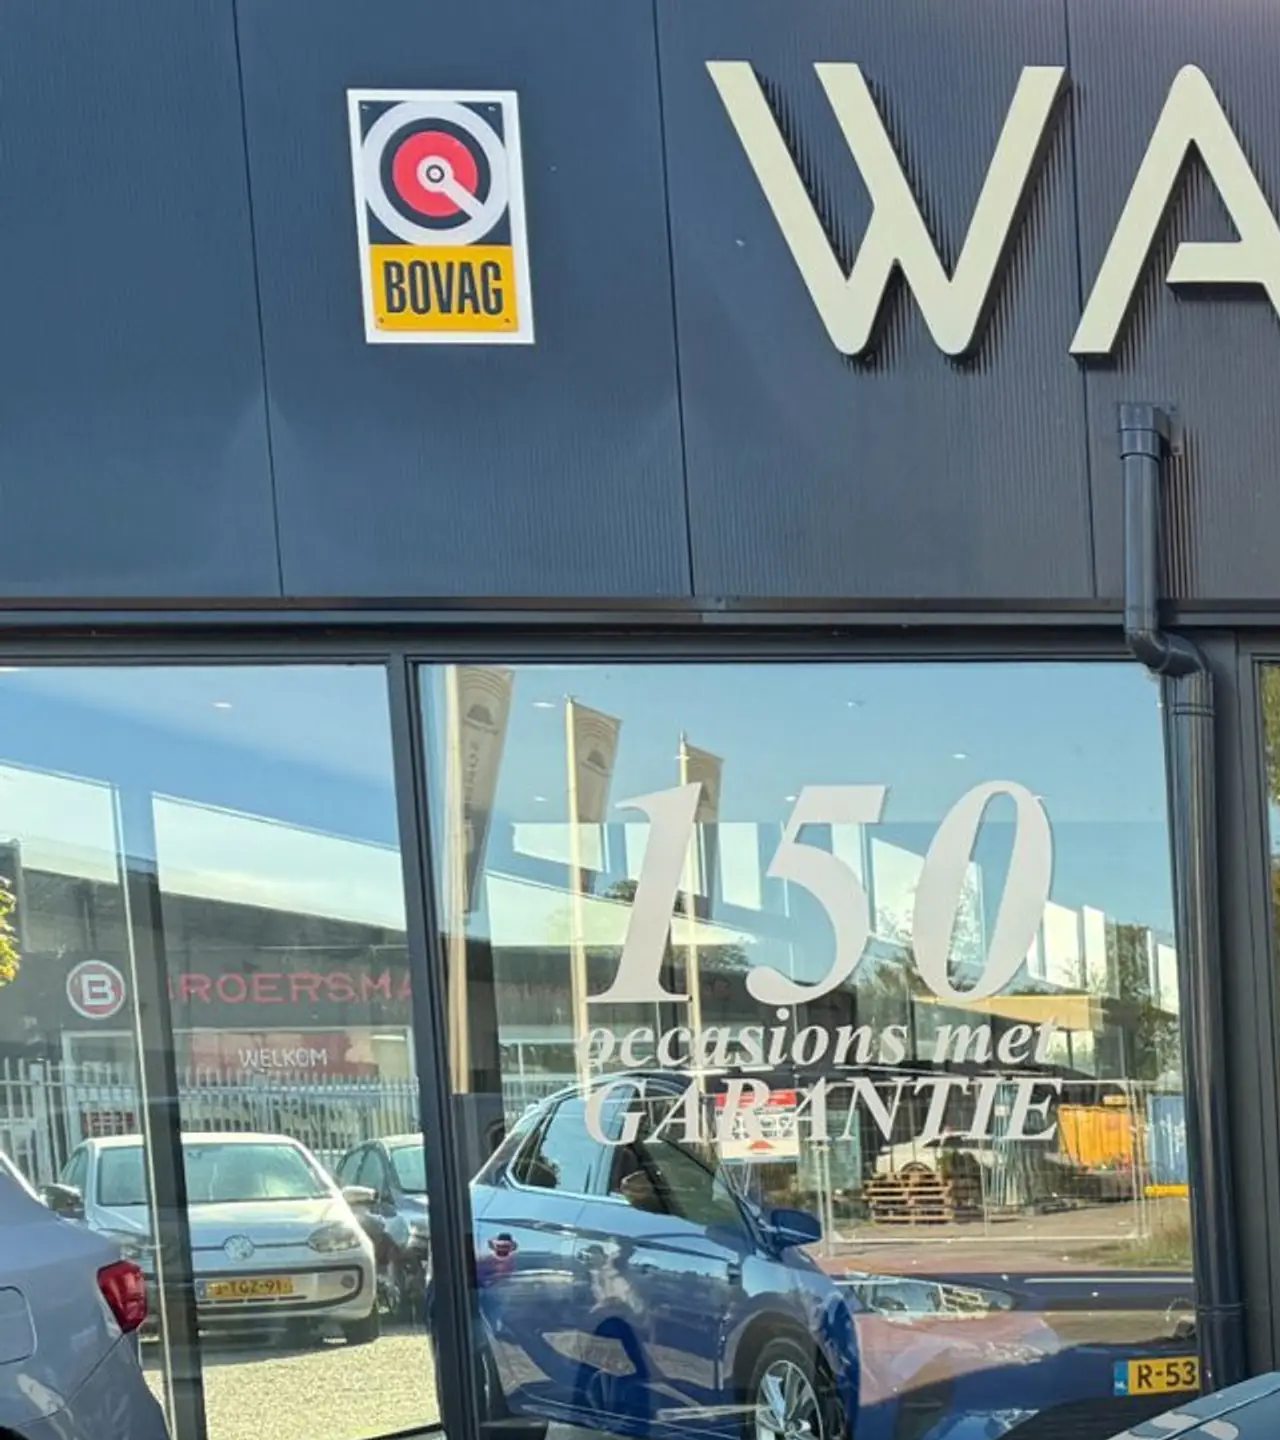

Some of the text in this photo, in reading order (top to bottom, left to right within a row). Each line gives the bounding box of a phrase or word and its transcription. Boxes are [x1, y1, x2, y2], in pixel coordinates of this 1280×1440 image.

[382, 259, 503, 316] BOVAG
[586, 779, 1054, 1006] 150
[238, 1047, 328, 1068] WELKOM
[580, 1006, 1054, 1069] occasions met
[584, 1077, 1062, 1147] GARANTIE
[1137, 1360, 1197, 1389] R-53
